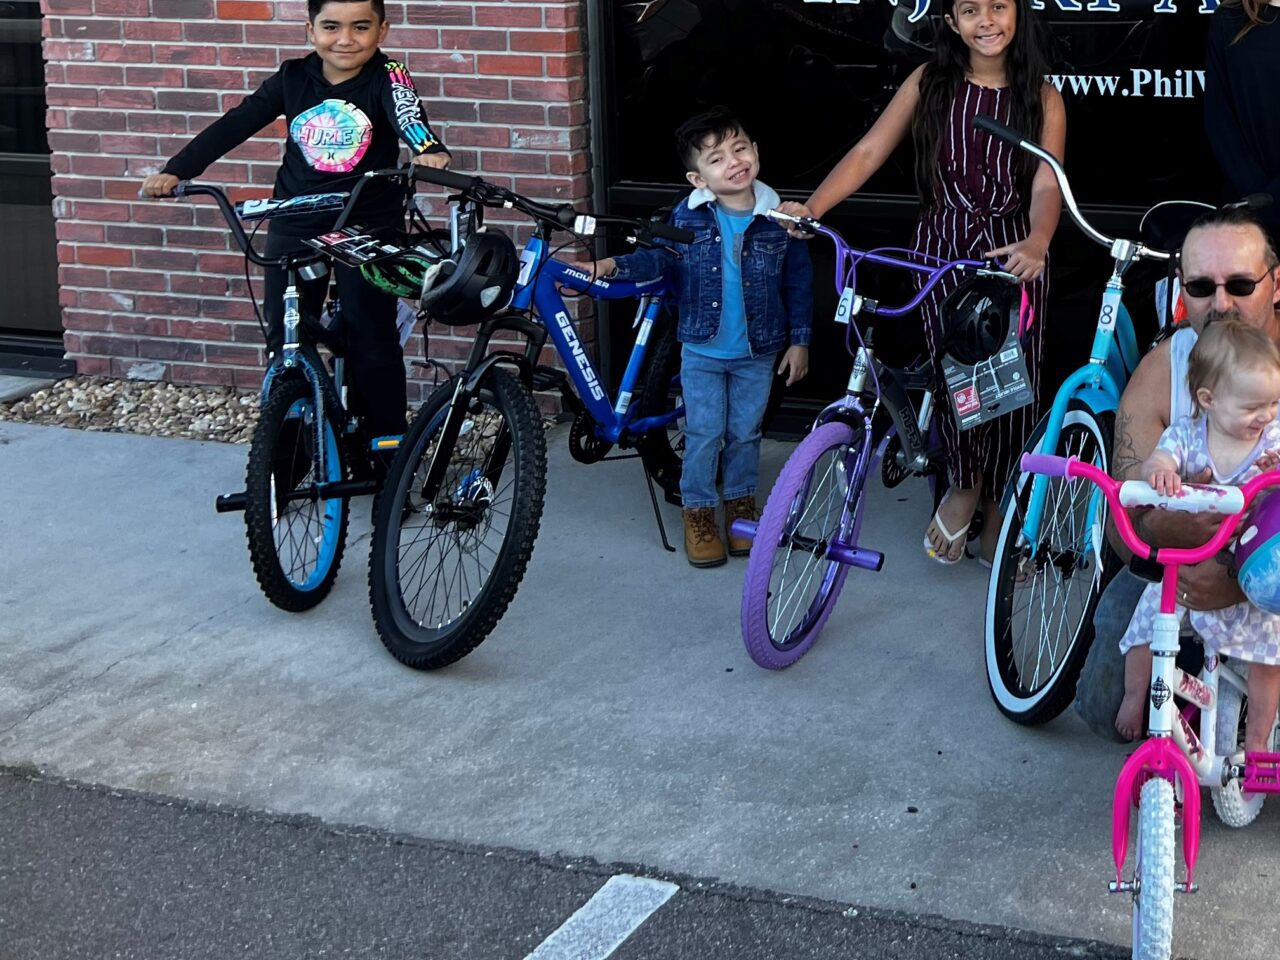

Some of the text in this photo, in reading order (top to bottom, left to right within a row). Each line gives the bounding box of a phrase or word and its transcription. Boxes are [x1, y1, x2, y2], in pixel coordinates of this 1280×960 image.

[297, 126, 365, 146] HURLEY
[837, 298, 849, 317] 6
[1100, 304, 1113, 325] 8
[555, 310, 605, 401] GENESIS
